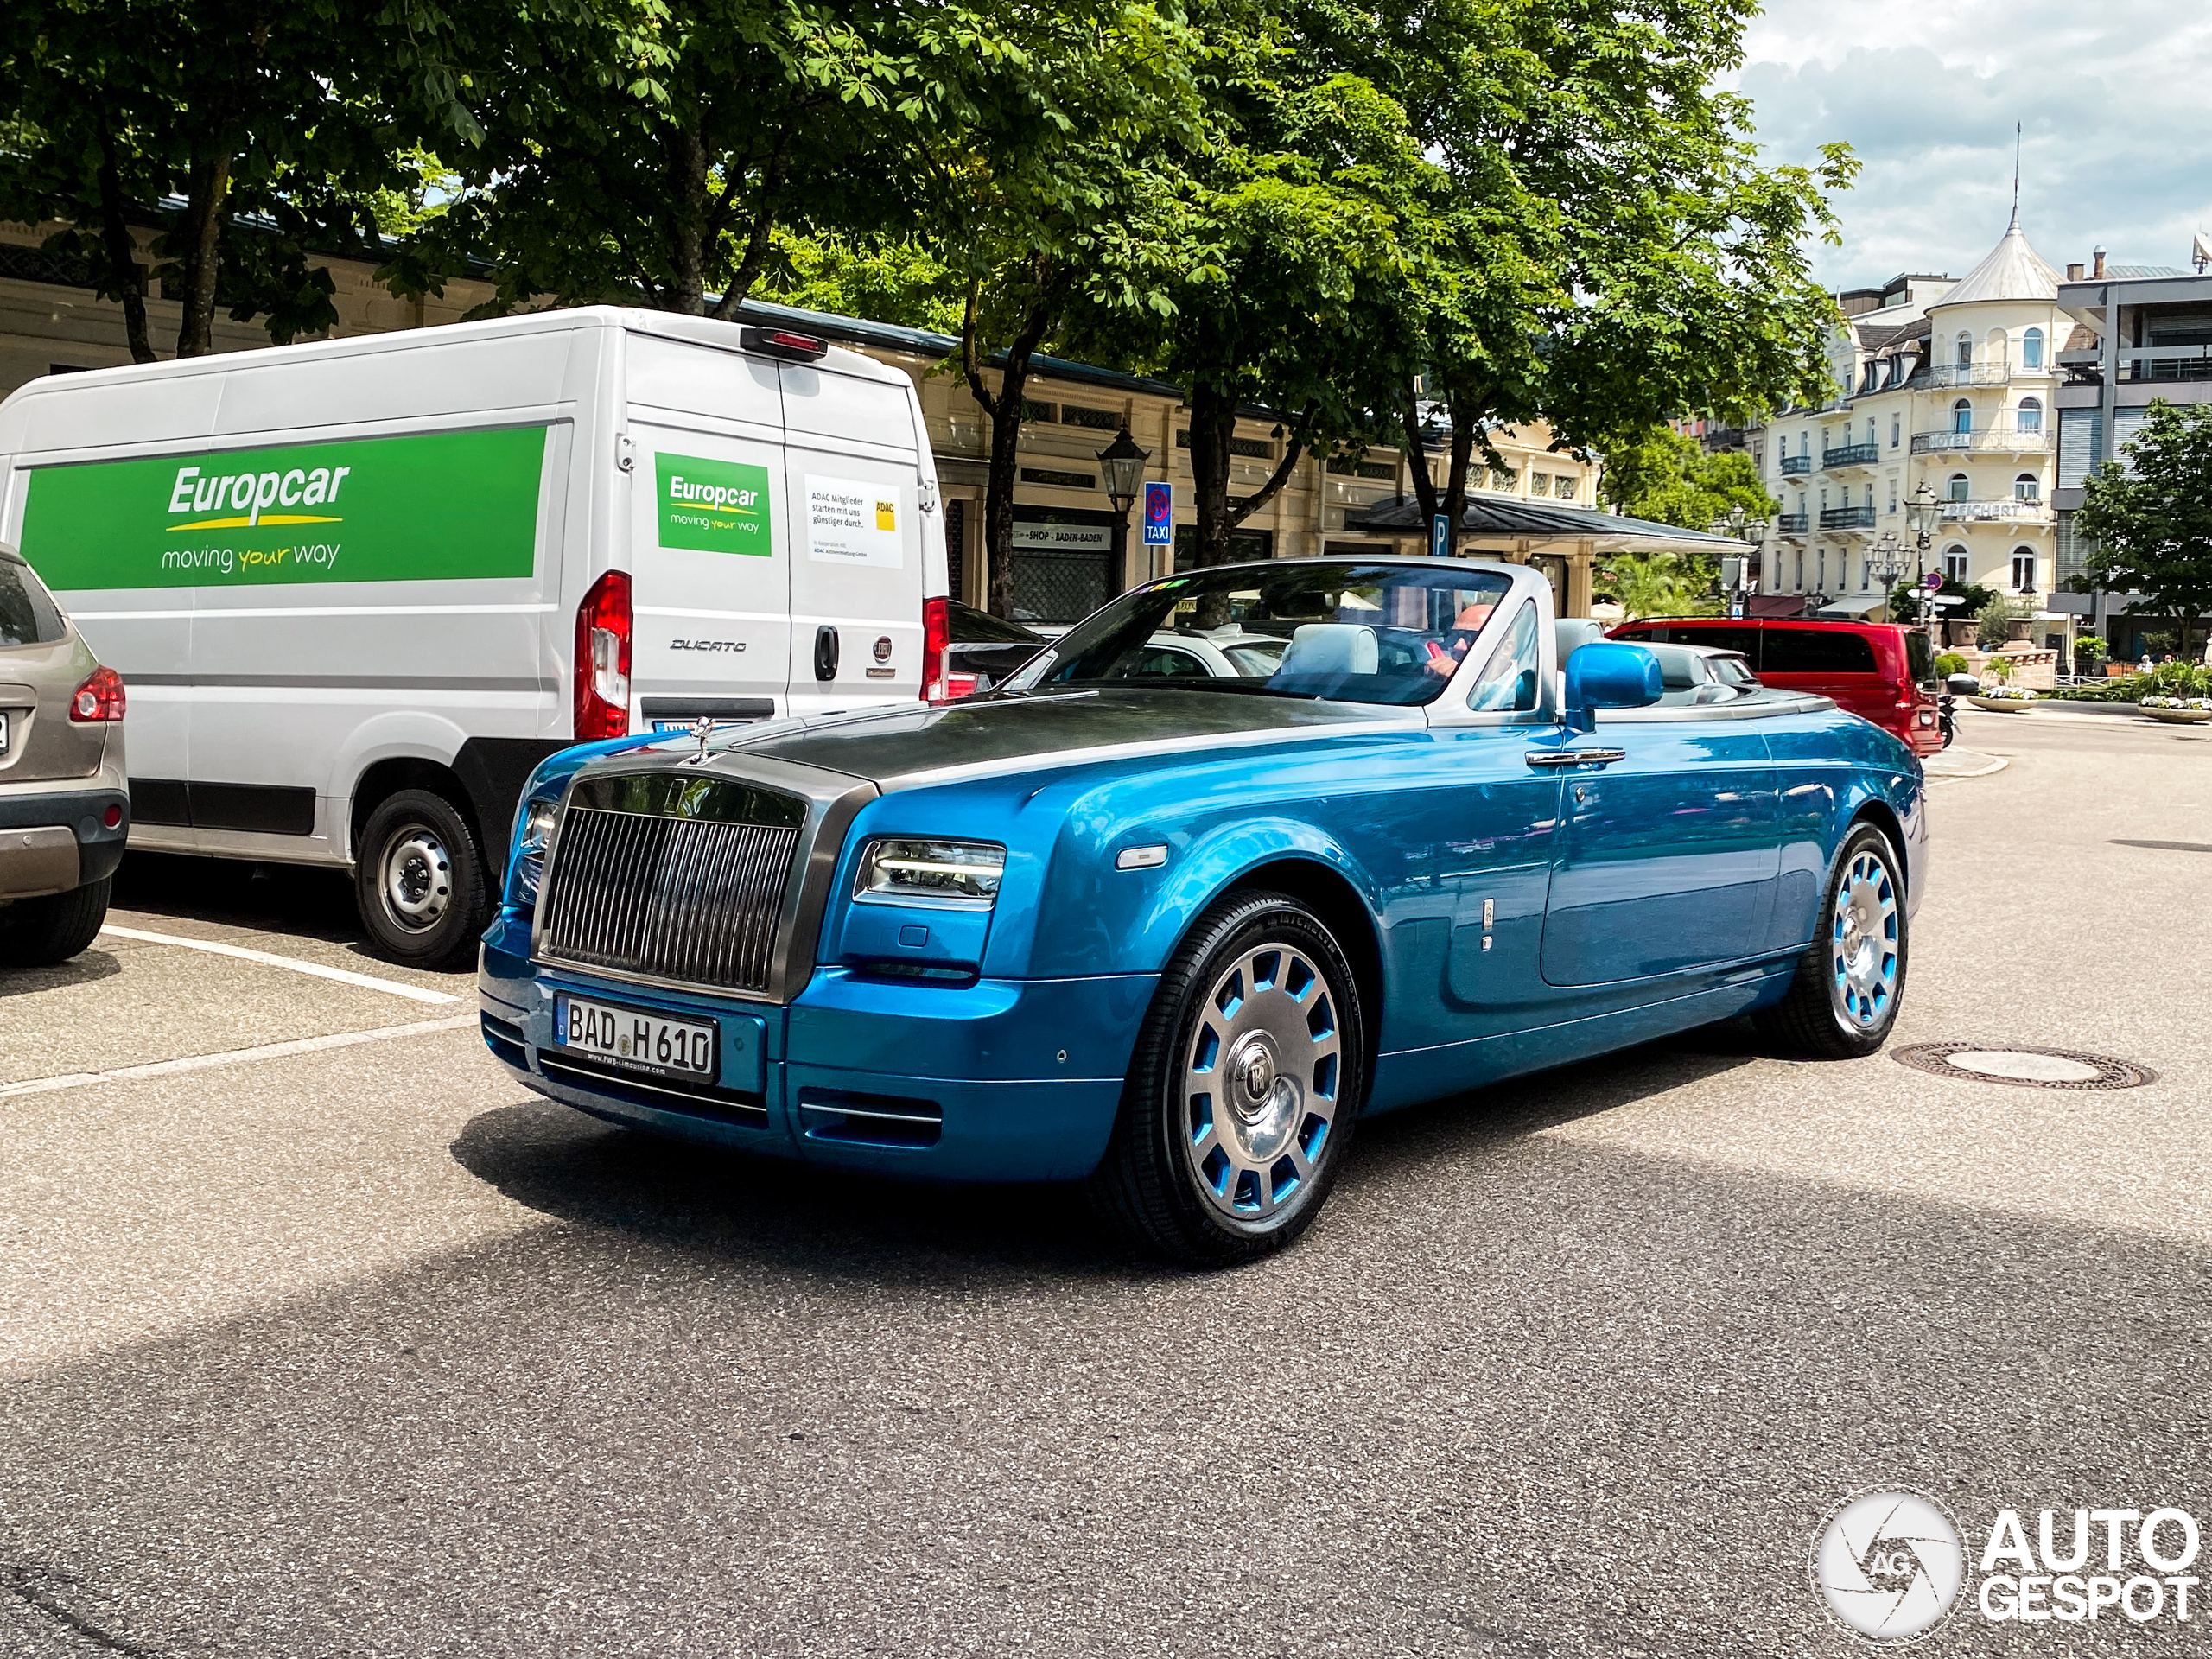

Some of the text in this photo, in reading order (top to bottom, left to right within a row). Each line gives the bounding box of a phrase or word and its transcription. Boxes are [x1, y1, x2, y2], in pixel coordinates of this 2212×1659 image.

[1931, 435, 1969, 447] HOTEL
[168, 467, 351, 527] Europcar
[670, 475, 759, 511] Europcar
[811, 492, 863, 506] ADAC Mitglieder
[812, 505, 836, 513] starten
[836, 506, 848, 515] mit
[876, 501, 894, 513] ADAC
[1949, 504, 2020, 517] REICHERT
[671, 514, 760, 535] moving your way
[812, 514, 864, 529] günstiger durch.
[1055, 531, 1103, 543] BADEN-BADEN
[1147, 525, 1169, 539] TAXI
[1437, 521, 1446, 556] P
[161, 543, 341, 574] moving your way
[670, 639, 747, 652] DUCATO
[1280, 912, 1337, 954] MICHELIN
[569, 1003, 616, 1050] BAD
